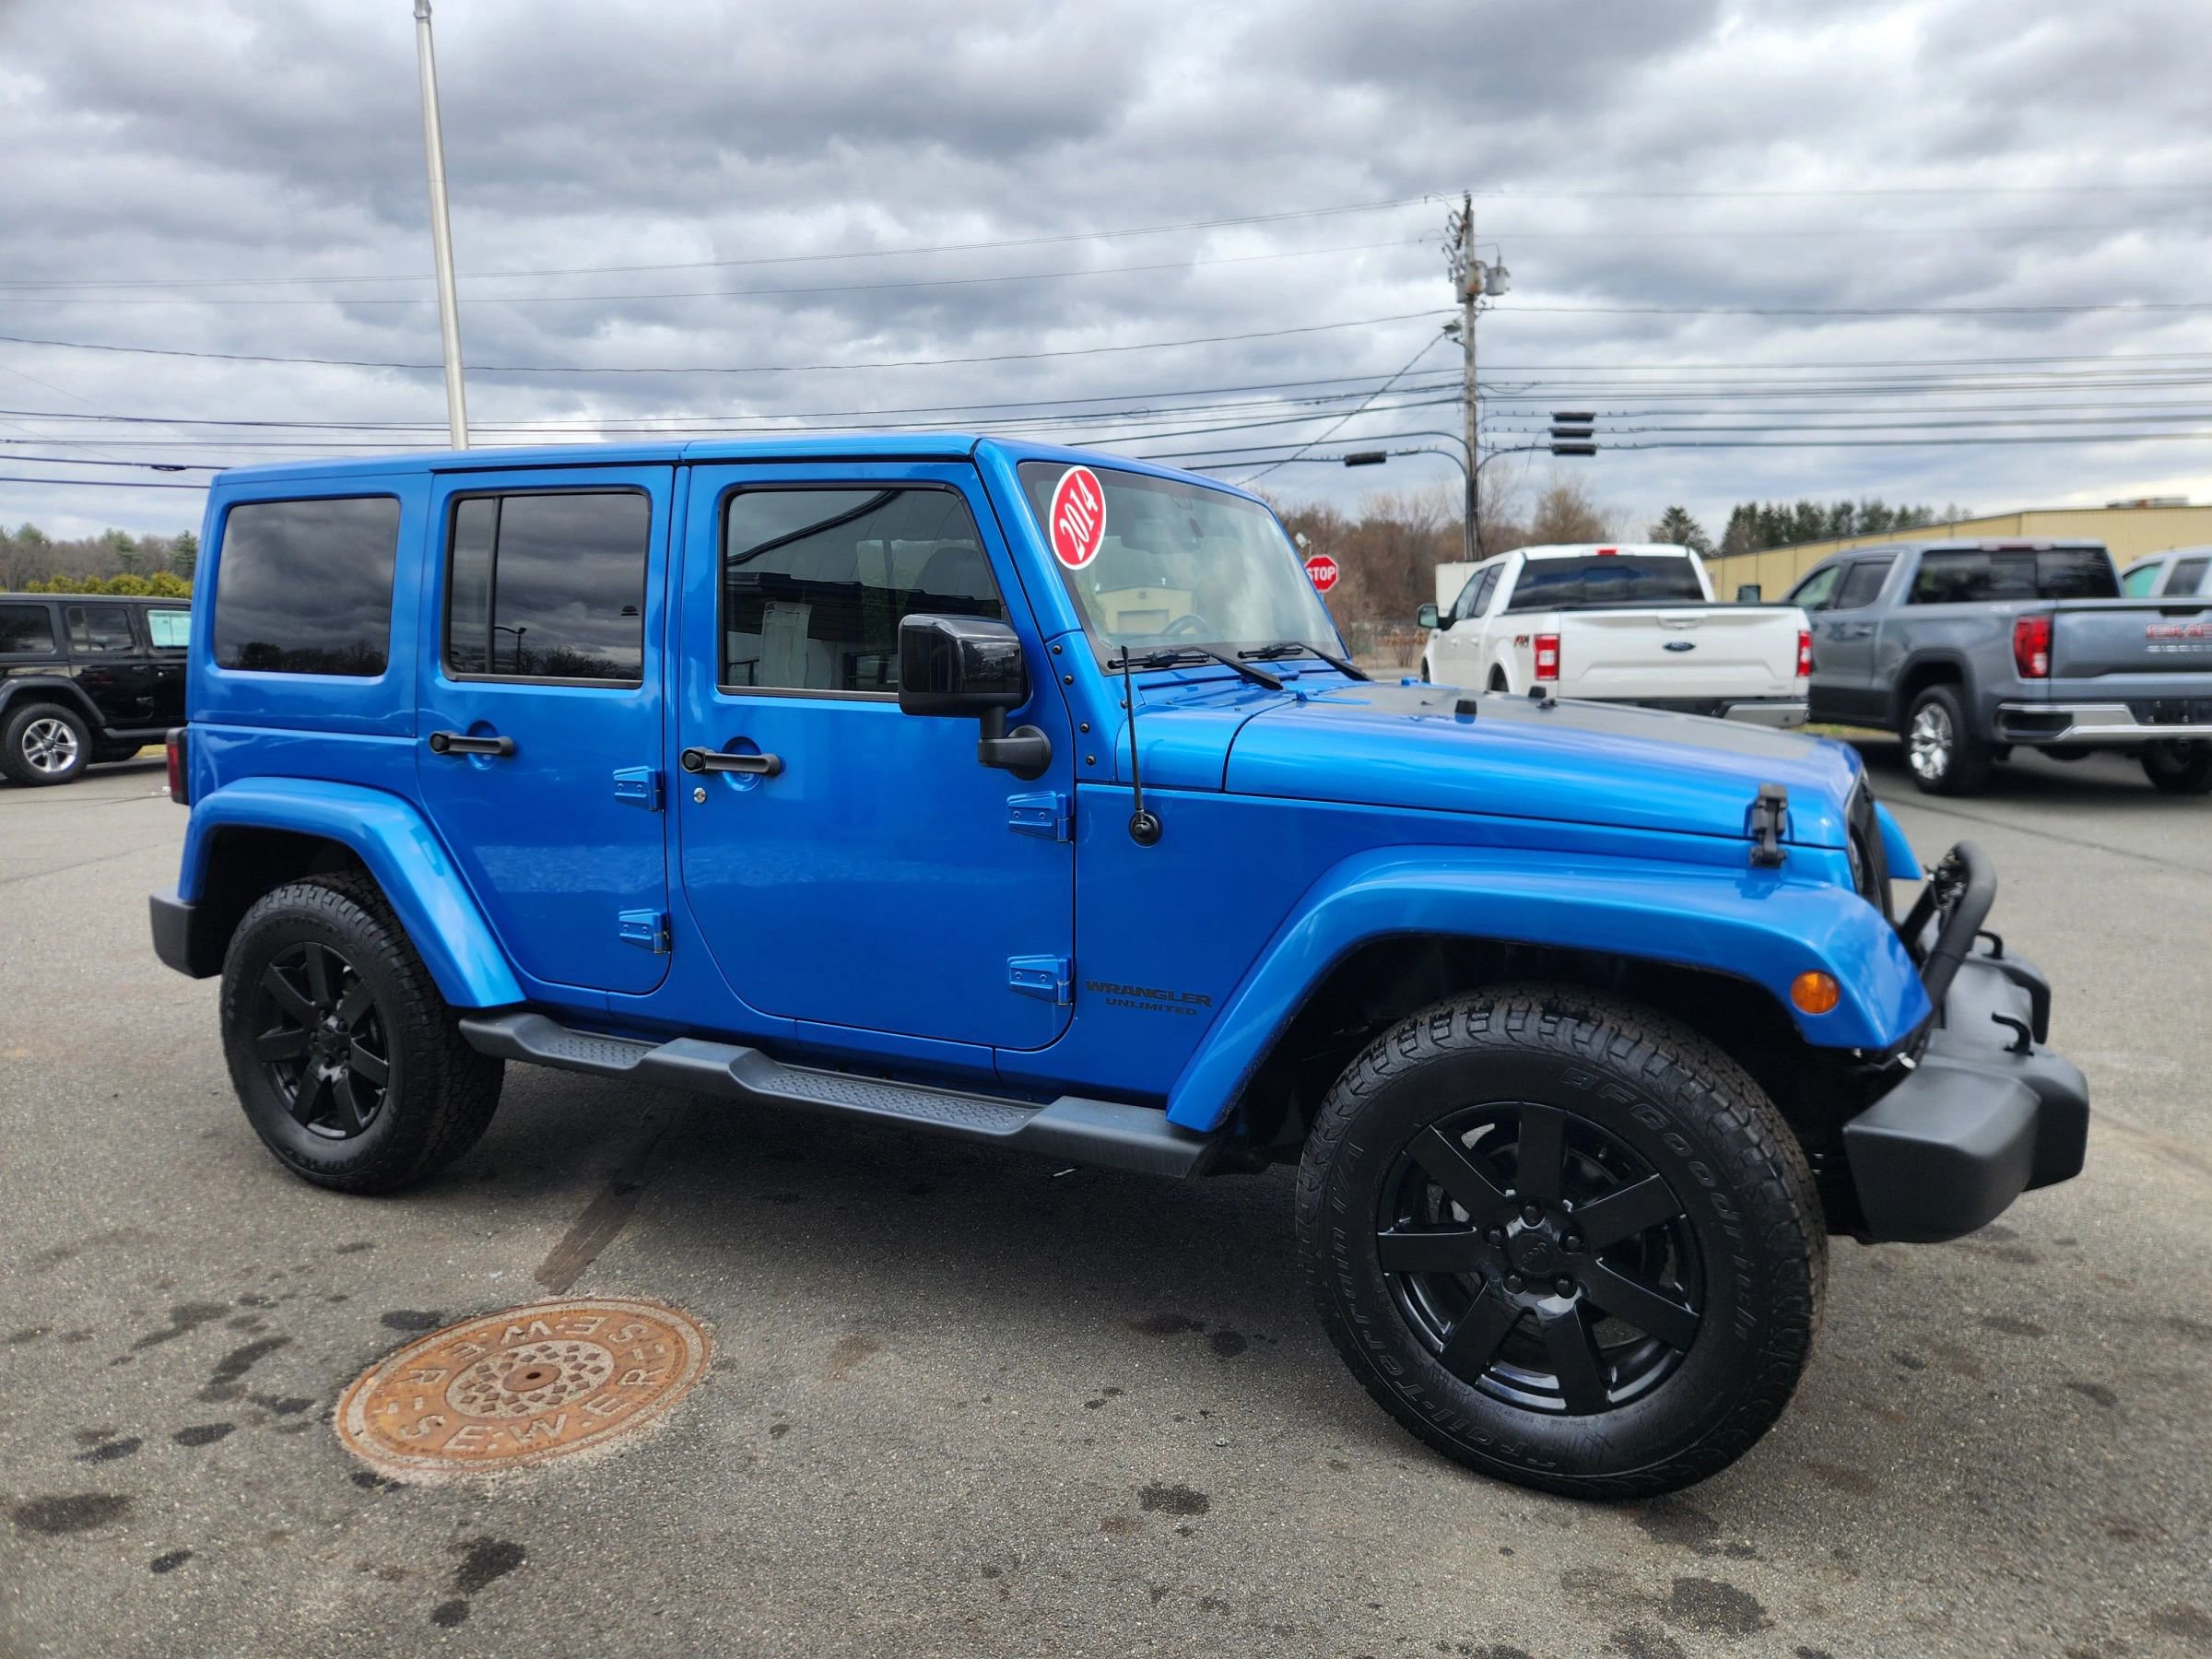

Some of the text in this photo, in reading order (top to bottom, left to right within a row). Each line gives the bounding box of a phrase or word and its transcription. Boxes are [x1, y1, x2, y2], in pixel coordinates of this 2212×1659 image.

[1059, 472, 1099, 561] 2014
[1306, 565, 1335, 582] STOP
[1085, 980, 1212, 1007] WRANGLER
[1105, 997, 1196, 1016] UNLIMITED
